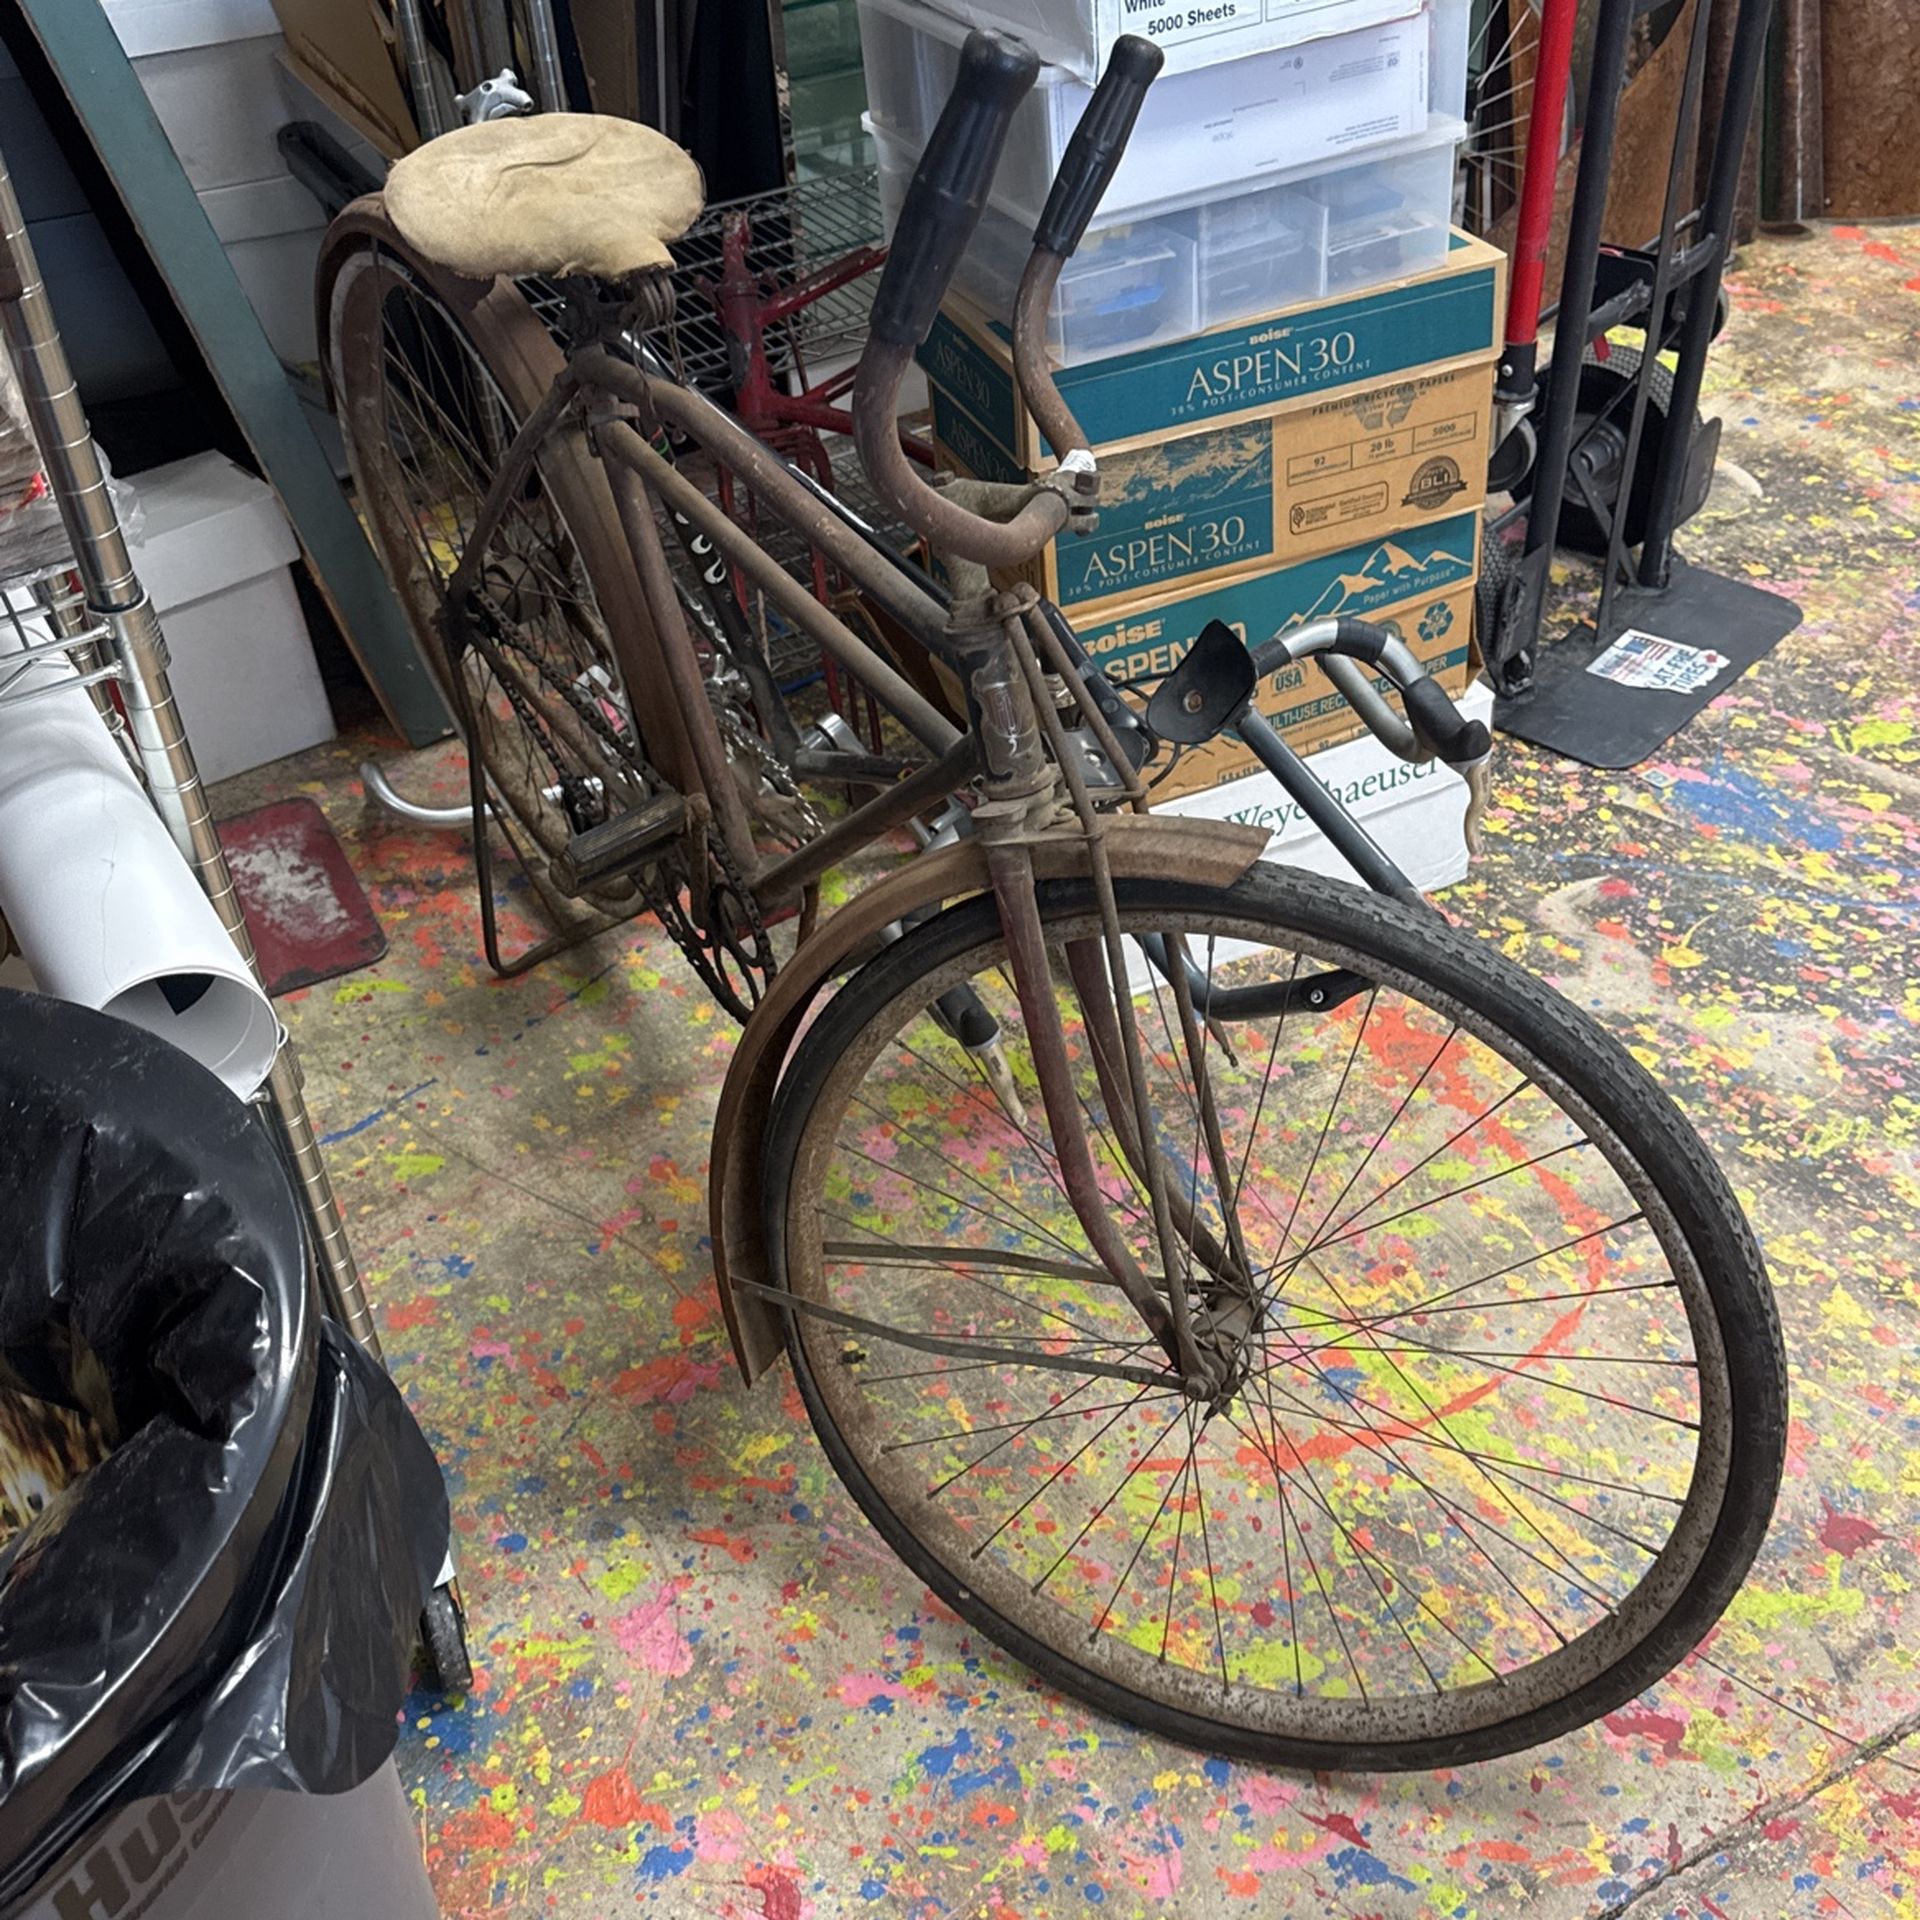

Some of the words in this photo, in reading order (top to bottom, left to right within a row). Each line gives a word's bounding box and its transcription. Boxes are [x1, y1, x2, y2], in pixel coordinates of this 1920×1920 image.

[1148, 14, 1183, 36] 5000
[1187, 3, 1236, 26] Sheets
[1186, 343, 1303, 402] ASPEN
[1309, 331, 1356, 372] 30
[1203, 374, 1307, 409] POST-CONSUMER
[1314, 359, 1371, 382] CONTENT
[1420, 472, 1449, 490] BLI
[1067, 583, 1092, 597] 30%
[1098, 557, 1199, 588] POST-CONSUMER
[1205, 540, 1260, 562] CONTENT
[1083, 527, 1193, 583] ASPEN
[1200, 515, 1245, 553] 30
[1363, 590, 1390, 605] Paper
[1392, 582, 1411, 594] with
[1104, 637, 1193, 684] SPEN
[1275, 668, 1303, 692] USA
[1270, 703, 1319, 728] ULTI-USE
